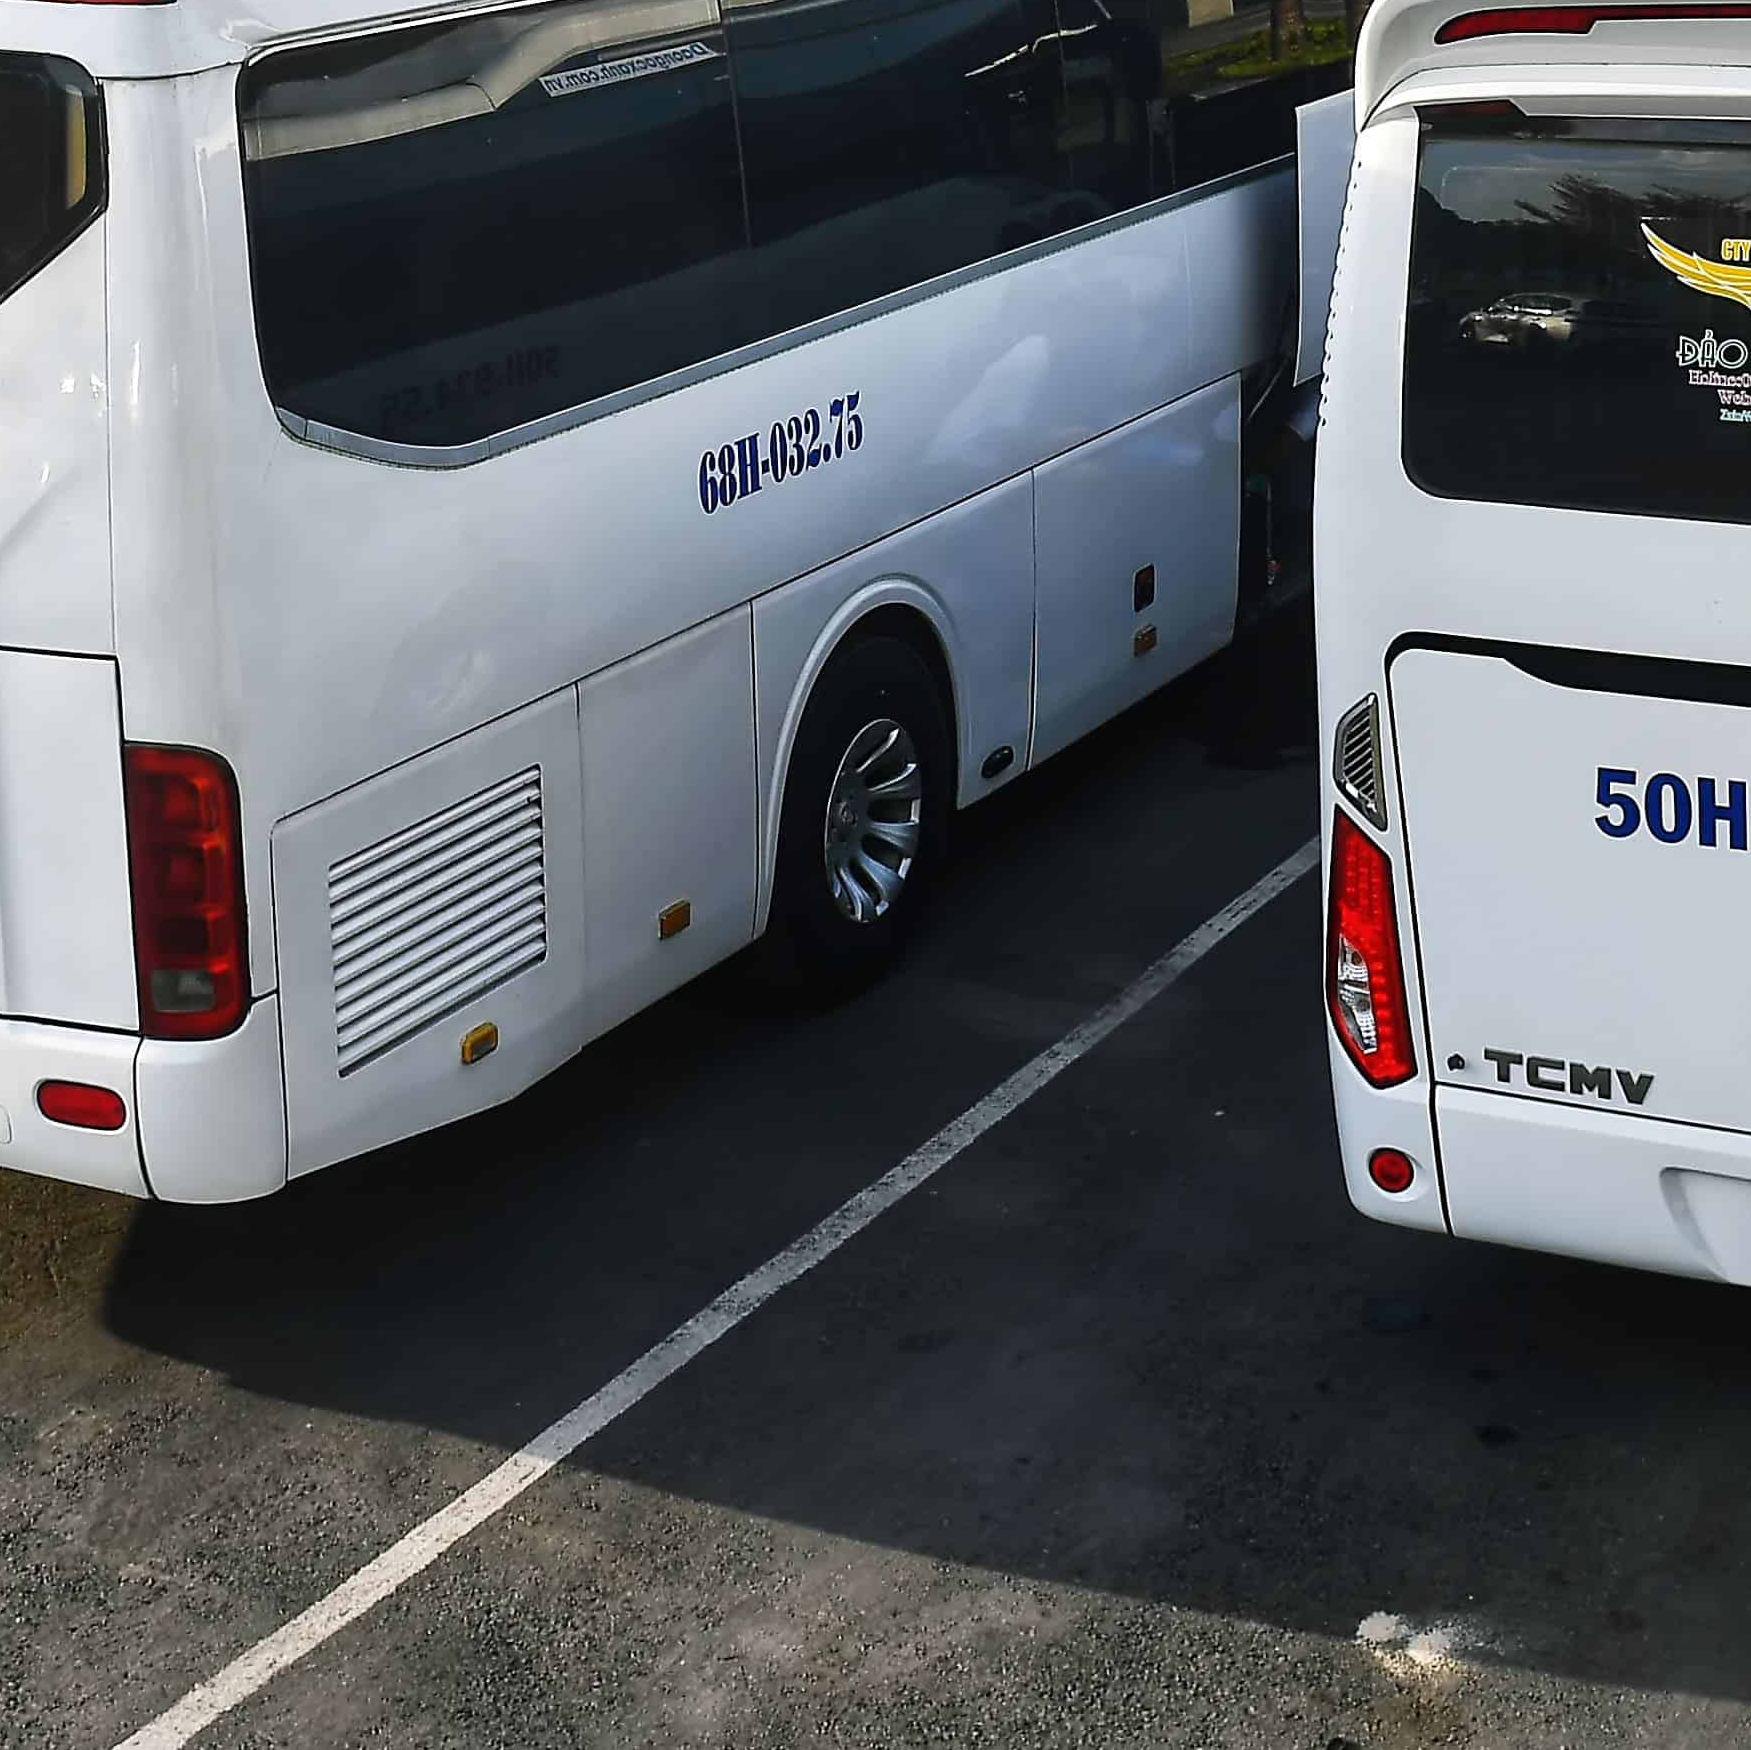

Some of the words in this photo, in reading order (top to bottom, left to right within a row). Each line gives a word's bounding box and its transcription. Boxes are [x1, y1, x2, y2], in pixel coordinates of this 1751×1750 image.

[1721, 238, 1751, 262] CTY
[1676, 329, 1748, 369] ĐẢO
[698, 390, 864, 515] 68H-032.75
[1483, 1047, 1656, 1107] TCMV
